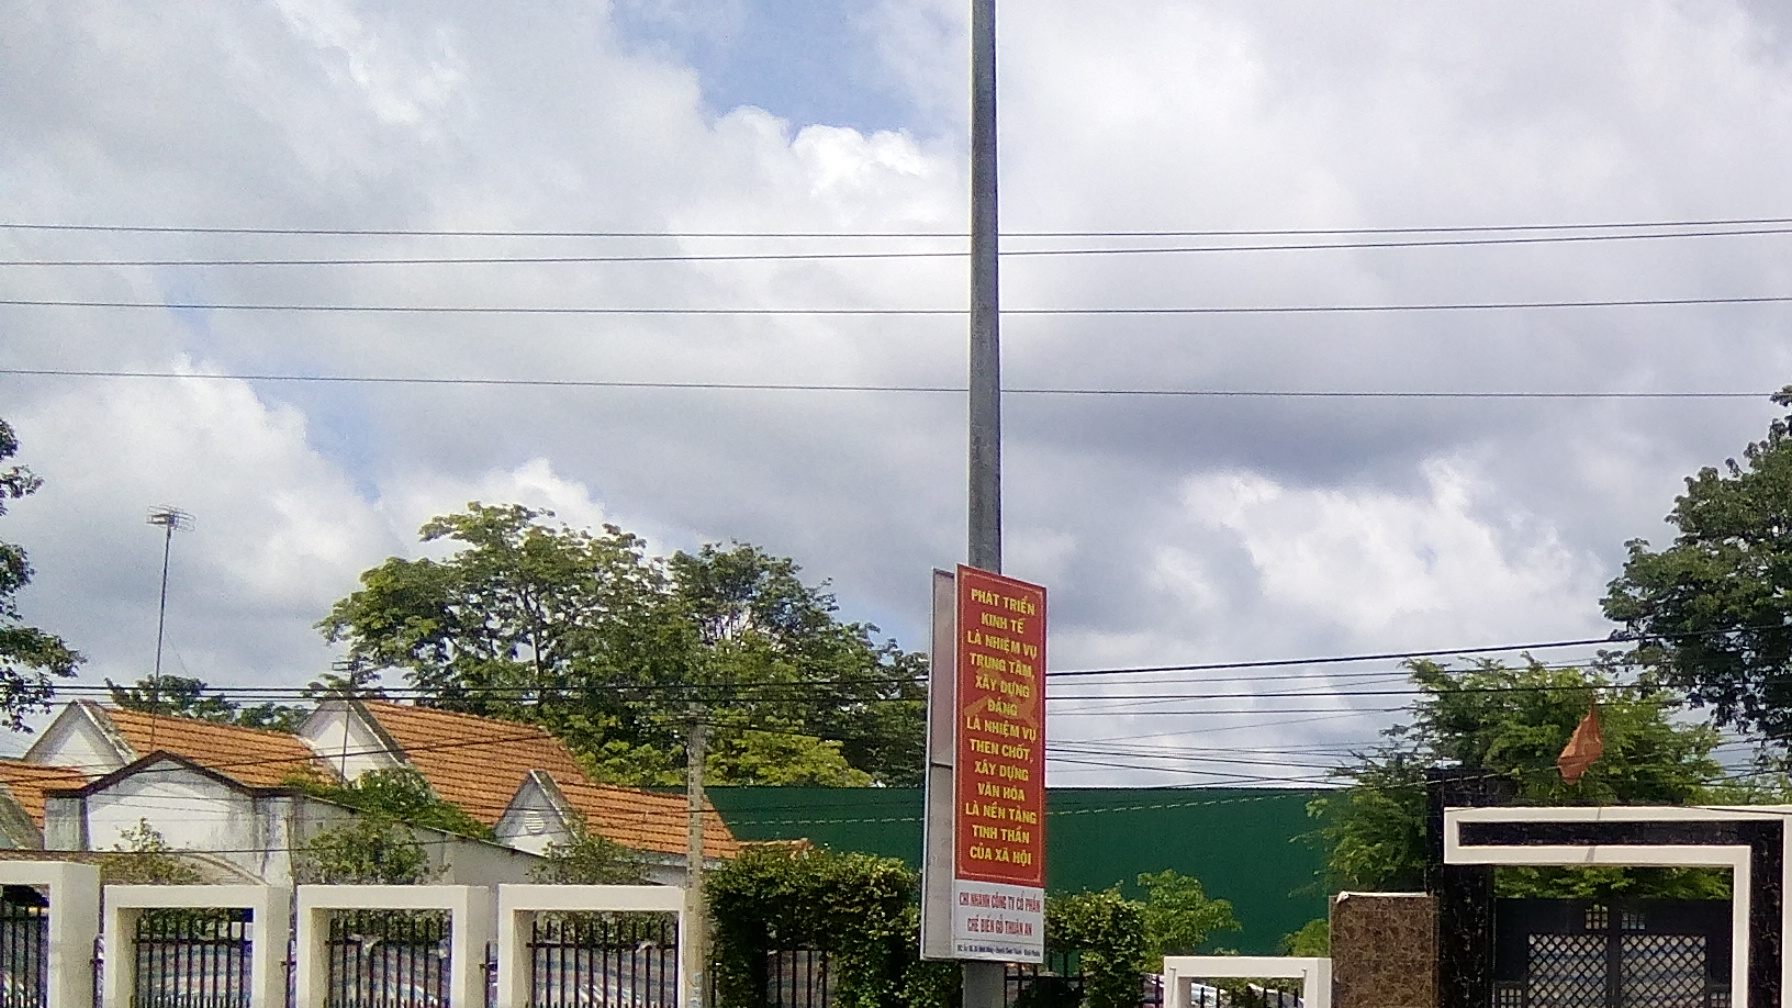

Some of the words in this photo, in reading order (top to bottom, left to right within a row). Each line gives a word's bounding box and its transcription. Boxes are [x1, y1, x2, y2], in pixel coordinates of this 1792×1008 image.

[971, 588, 1000, 606] PHÁT
[1003, 595, 1035, 616] TRIỂN
[981, 612, 1008, 630] KINH
[1010, 617, 1026, 634] TẾ
[967, 628, 982, 646] LÀ
[985, 634, 1021, 655] NHIỆM
[1022, 643, 1038, 660] VỤ
[969, 652, 1006, 672] TRUNG
[1008, 660, 1035, 681] TÂM,
[975, 674, 997, 692] XÂY
[1000, 680, 1030, 698] DỰNG
[966, 714, 981, 731] LÀ
[984, 719, 1020, 738] NHIỆM
[1021, 726, 1036, 744] VỤ
[969, 738, 999, 755] THEN
[1001, 743, 1034, 764] CHỐT,
[974, 758, 997, 776] XÂY
[1000, 765, 1029, 782] DỰNG
[965, 800, 980, 816] LÀ
[972, 824, 998, 840] TINH
[970, 841, 993, 860] CỦA
[995, 847, 1010, 863] XÃ
[1012, 849, 1032, 867] HỘI
[1008, 896, 1015, 911] TY
